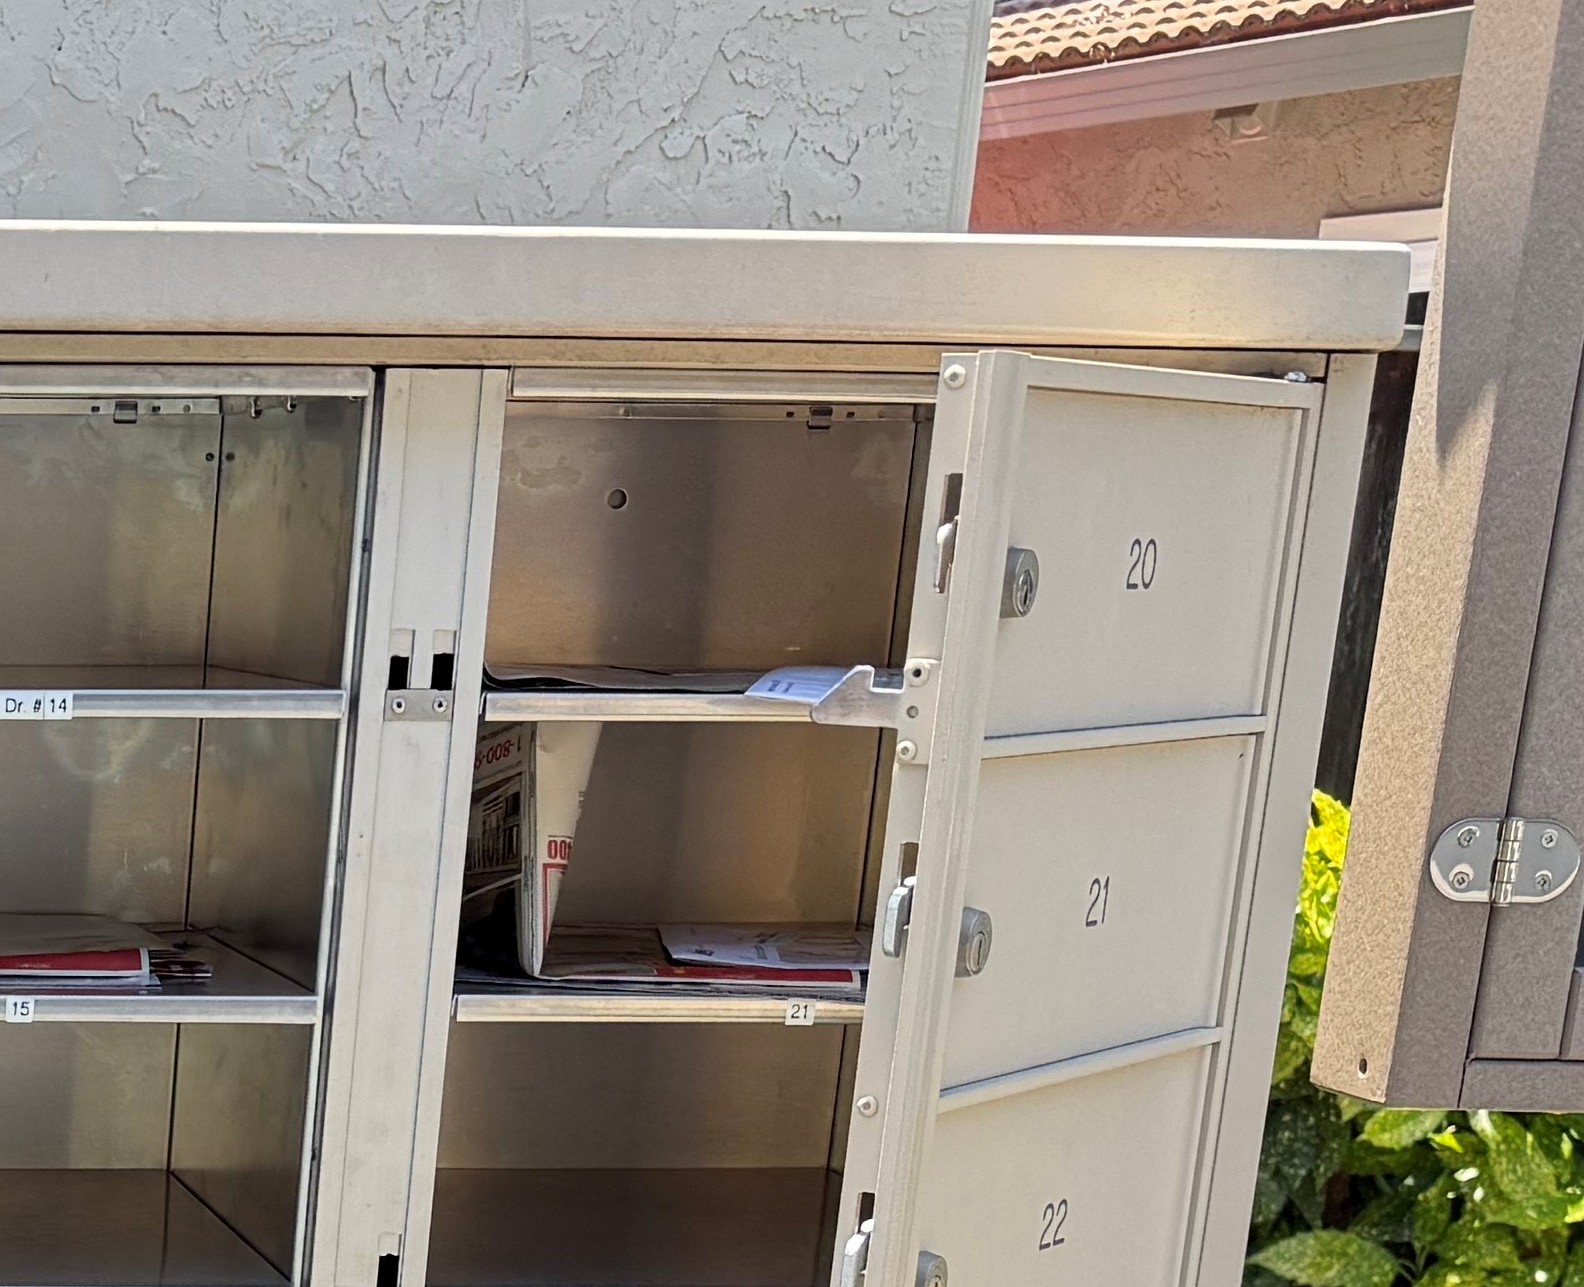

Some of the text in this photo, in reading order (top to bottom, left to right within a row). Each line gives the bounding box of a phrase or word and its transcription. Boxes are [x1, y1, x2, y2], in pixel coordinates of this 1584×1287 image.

[1126, 537, 1157, 590] 20
[49, 697, 67, 713] 14
[1085, 876, 1110, 928] 21
[12, 1001, 30, 1017] 15
[790, 1003, 809, 1020] 21
[1038, 1198, 1068, 1251] 22
